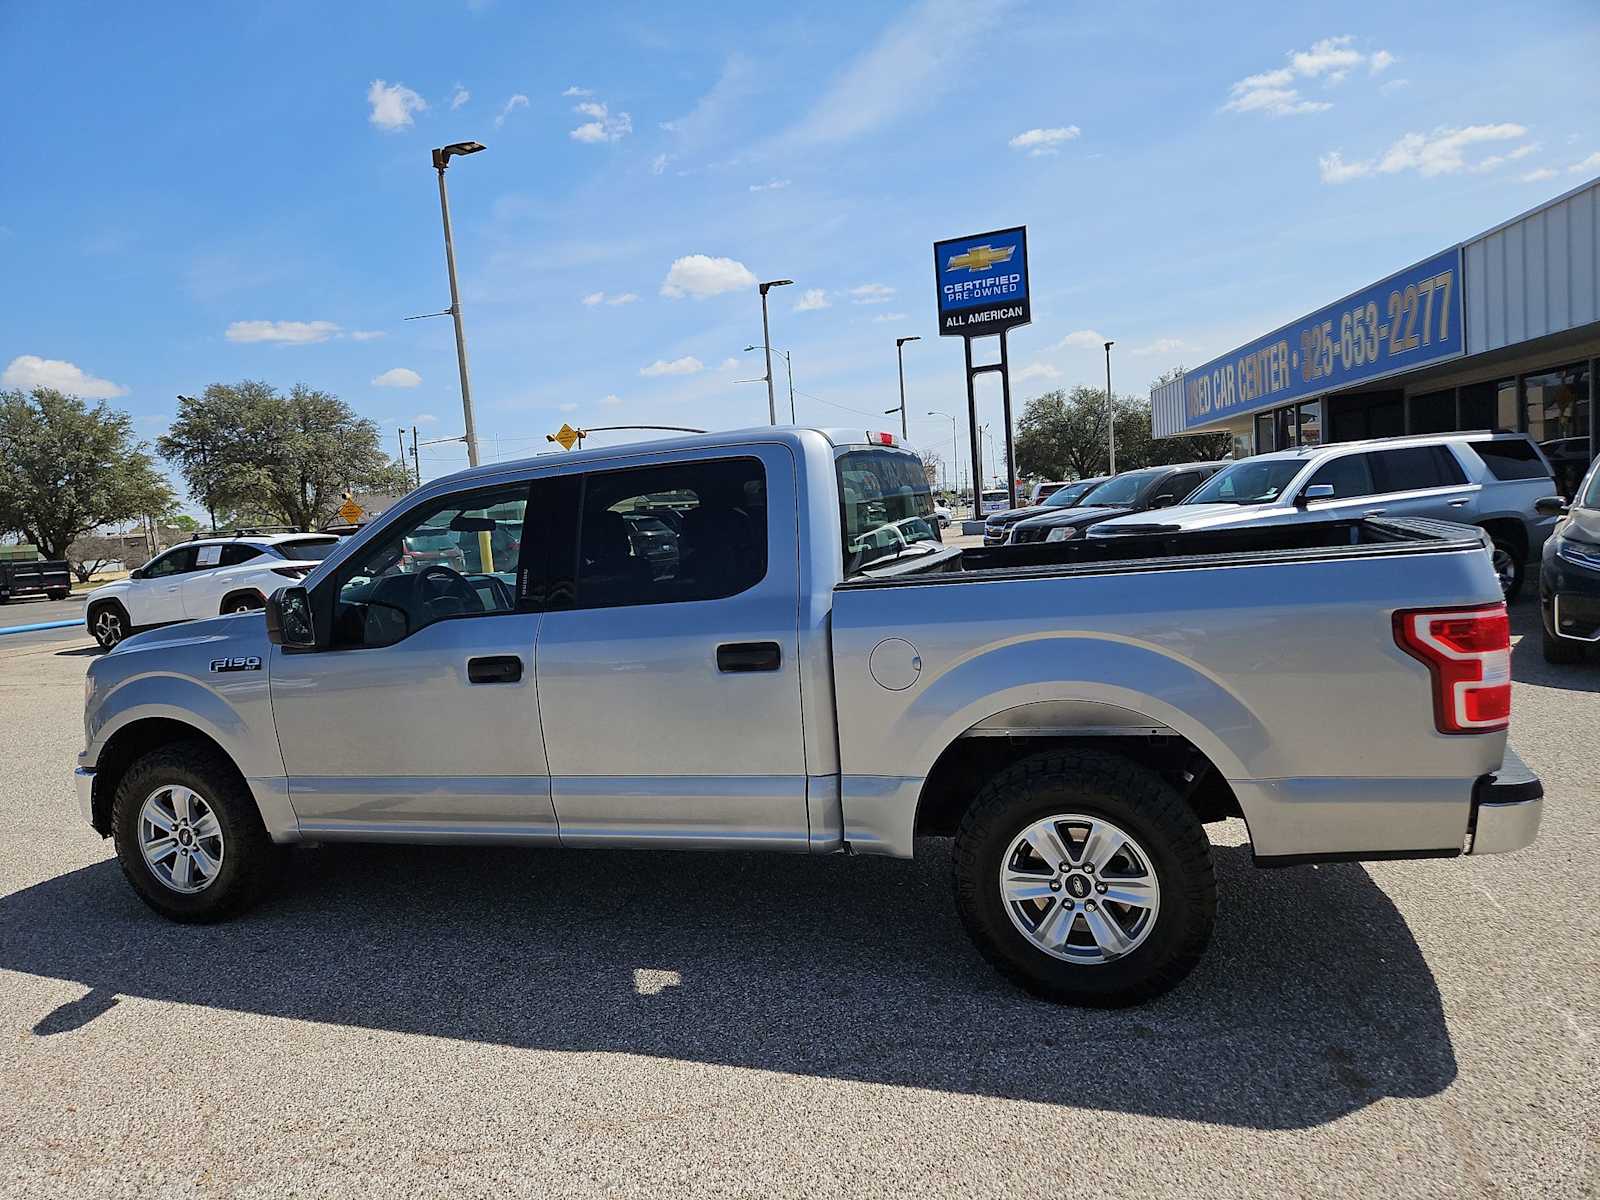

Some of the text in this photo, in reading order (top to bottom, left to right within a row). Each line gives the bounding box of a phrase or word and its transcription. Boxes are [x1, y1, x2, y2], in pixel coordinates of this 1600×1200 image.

[943, 273, 1020, 294] CERTIFIED
[947, 283, 1017, 303] PRE-OWNED
[945, 305, 1023, 328] ALL AMERICAN
[1213, 364, 1237, 409] CAR
[1238, 340, 1290, 402] CENTER
